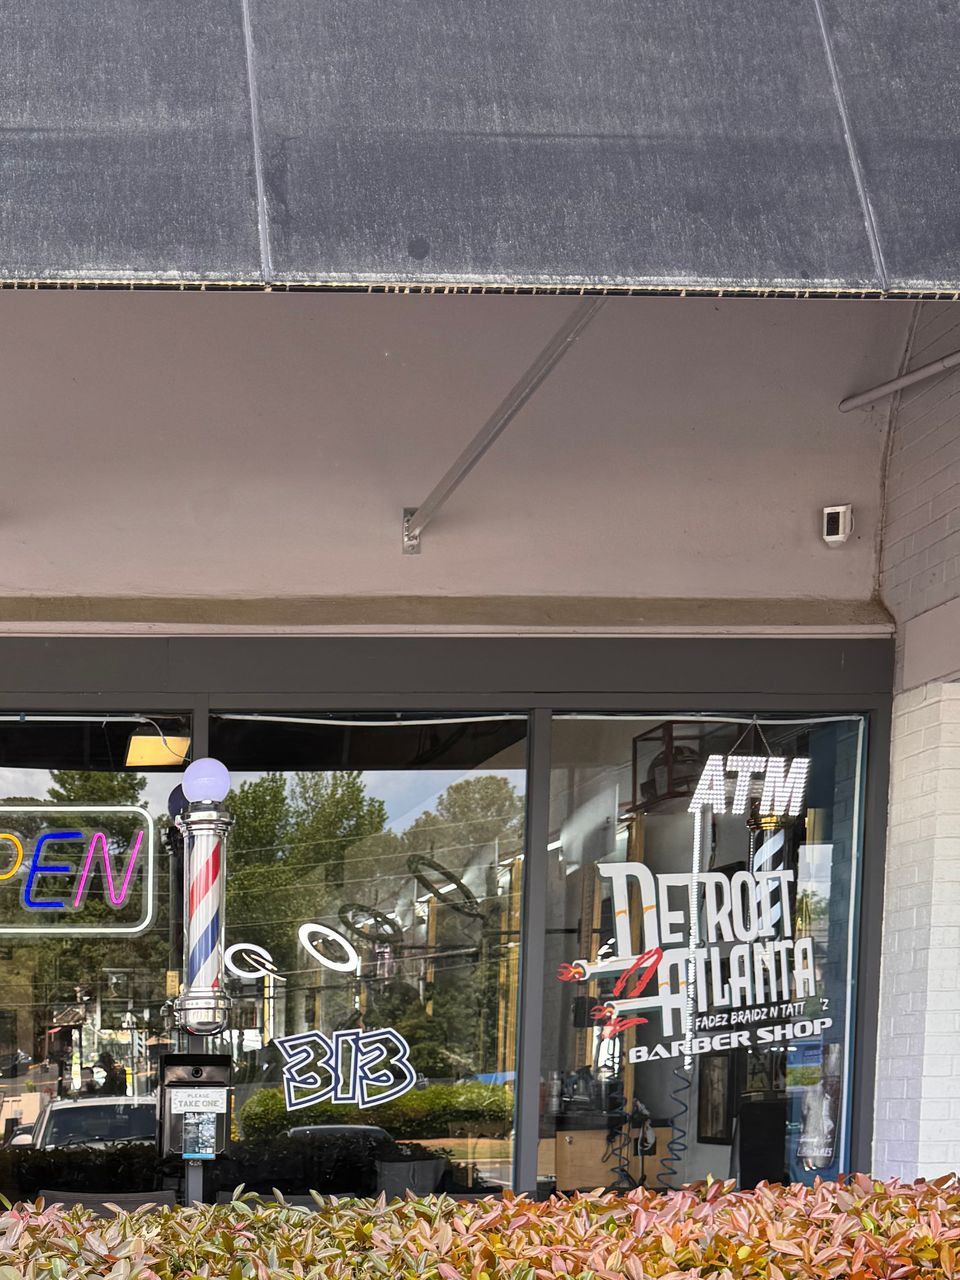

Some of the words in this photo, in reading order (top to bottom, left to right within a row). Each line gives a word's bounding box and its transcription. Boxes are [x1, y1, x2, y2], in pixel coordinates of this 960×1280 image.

[687, 754, 811, 816] ATM
[596, 862, 796, 964] DETROIT
[654, 937, 816, 1038] ATLANTA
[695, 1013, 729, 1031] FADEZ
[730, 1007, 768, 1025] BRAIDZ
[769, 1006, 779, 1019] N
[274, 1027, 417, 1112] 313
[628, 1030, 752, 1064] BARBER
[756, 1017, 833, 1044] SHOP
[178, 1100, 200, 1108] TAKE
[201, 1100, 220, 1108] ONE
